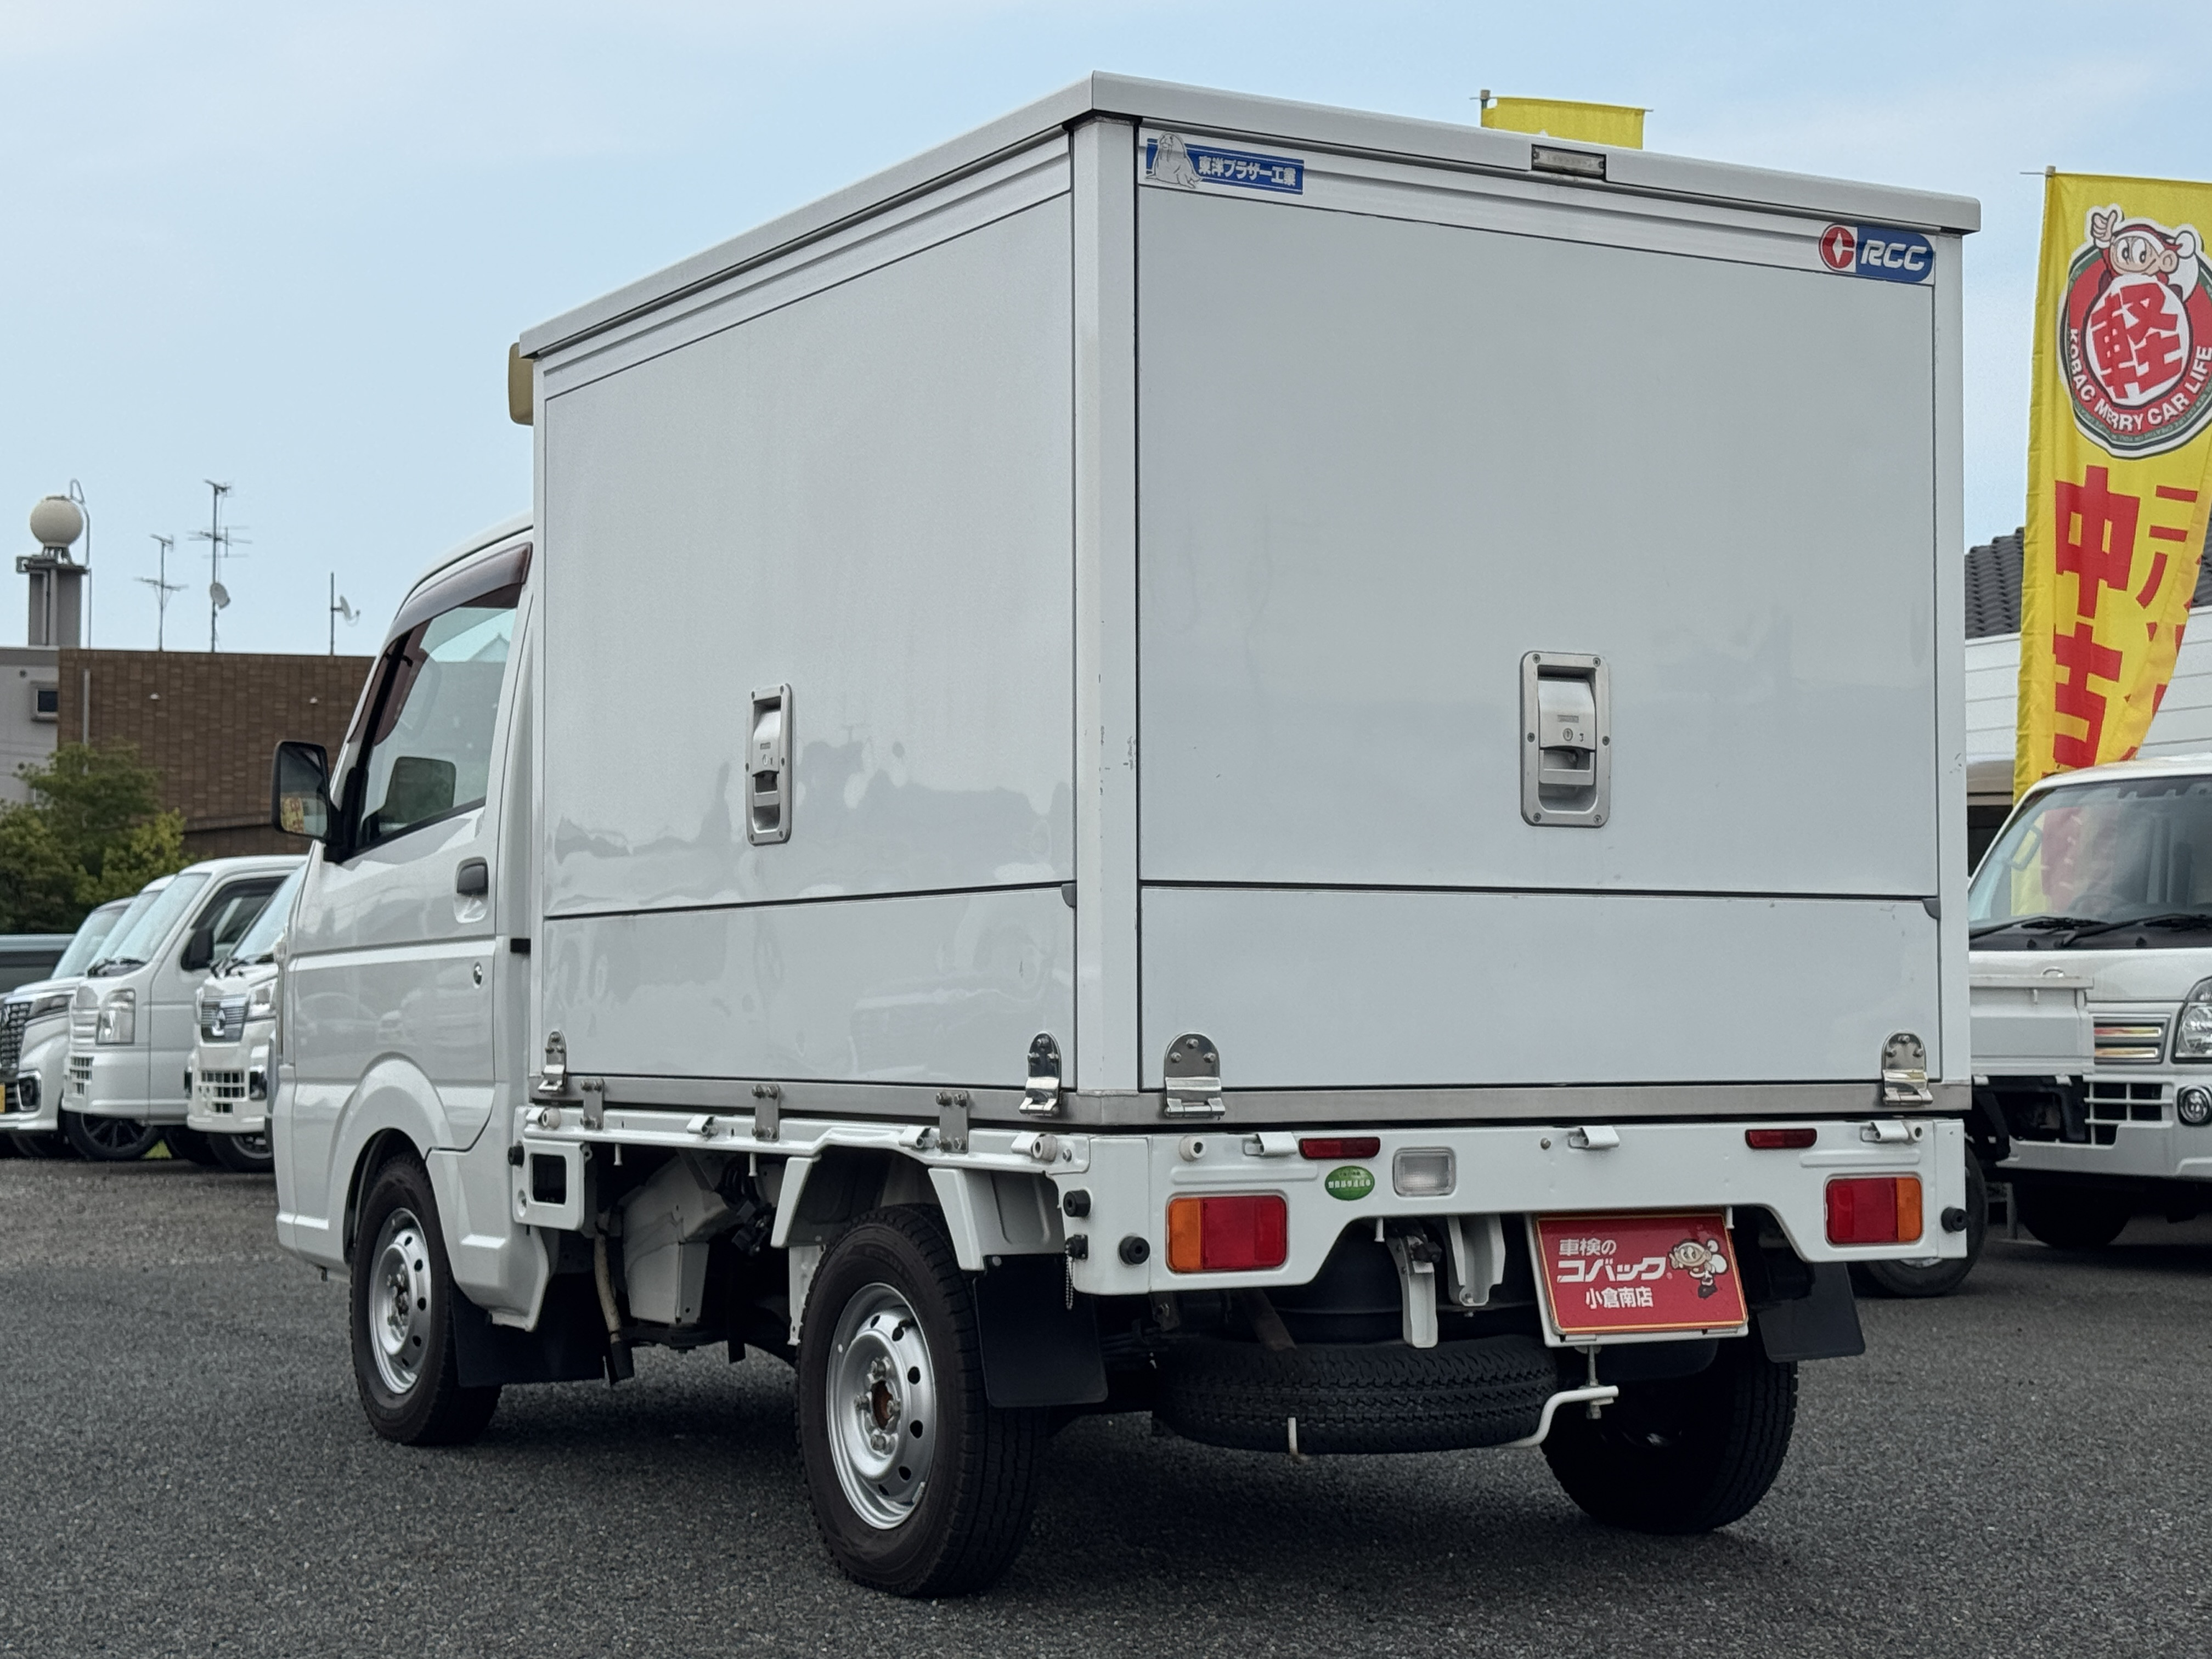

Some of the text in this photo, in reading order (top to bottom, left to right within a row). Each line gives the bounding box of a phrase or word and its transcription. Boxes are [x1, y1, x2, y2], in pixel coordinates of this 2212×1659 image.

[1860, 239, 1928, 272] RCC
[2090, 282, 2183, 399] 軽
[2069, 328, 2096, 401] KOBAC
[2147, 392, 2191, 425] CAR
[2184, 346, 2212, 394] LIFE
[1559, 1238, 1617, 1256] 車検の
[1557, 1256, 1667, 1283] コバック
[1585, 1285, 1654, 1310] 小倉南店
